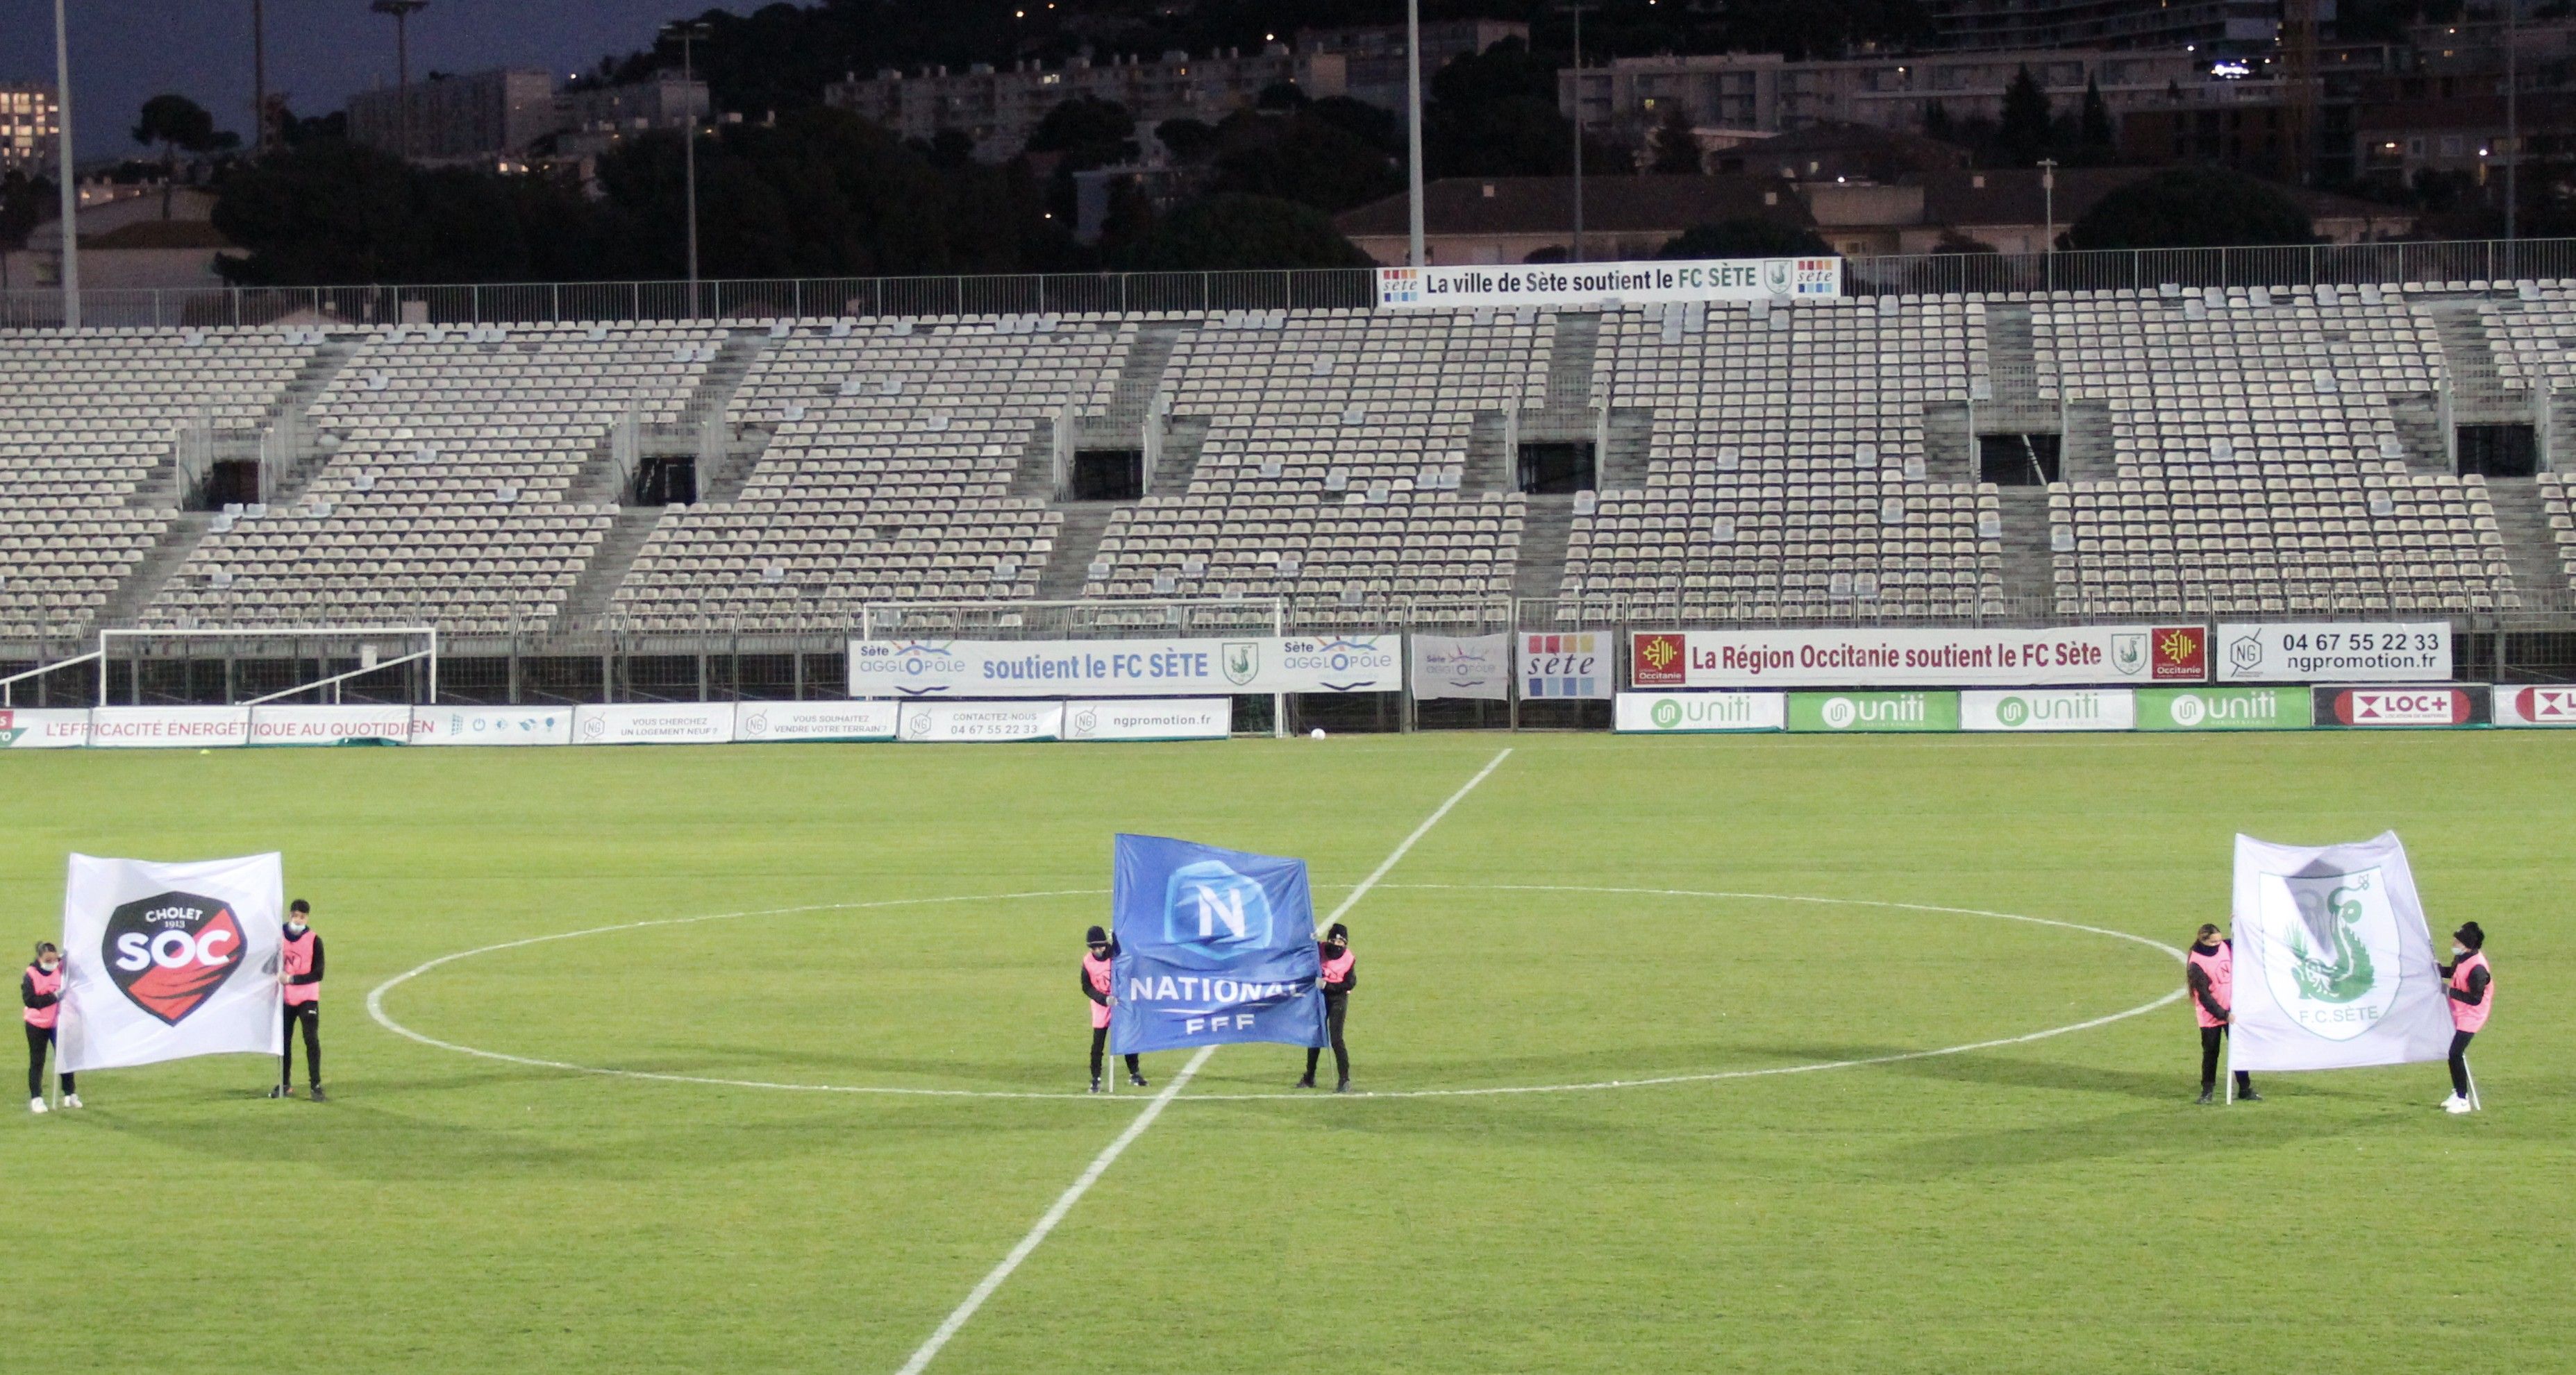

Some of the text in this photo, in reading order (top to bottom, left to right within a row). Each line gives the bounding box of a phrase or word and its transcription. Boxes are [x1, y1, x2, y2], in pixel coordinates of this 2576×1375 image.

[1427, 262, 1756, 293] La ville de Sète soutient le FC SÈTE
[1285, 641, 1314, 653] Sète
[2283, 633, 2439, 650] 04 67 55 22 33
[860, 646, 889, 657] Sète
[1693, 641, 2102, 675] La Région Occitanie soutient le FC Sète
[2236, 644, 2256, 661] NG
[983, 648, 1209, 679] soutient le FC SÈTE
[2157, 666, 2201, 675] Occitanie
[2287, 652, 2437, 672] ngpromotion.fr
[1687, 695, 1750, 721] uniti
[1859, 694, 1924, 721] uniti
[2033, 692, 2098, 720] uniti
[2209, 691, 2275, 719] uniti
[2385, 695, 2448, 711] LOC+
[914, 719, 927, 729] NG
[1079, 716, 1092, 726] NG
[1114, 714, 1211, 727] ngpromotion.fr
[301, 723, 325, 736] AU
[951, 725, 1037, 734] 04 67 55 22 33
[145, 906, 203, 922] CHOLET
[1196, 885, 1245, 937] N
[165, 920, 185, 929] 1913
[116, 929, 231, 971] SOC
[1130, 976, 1307, 1002] NATIONAL
